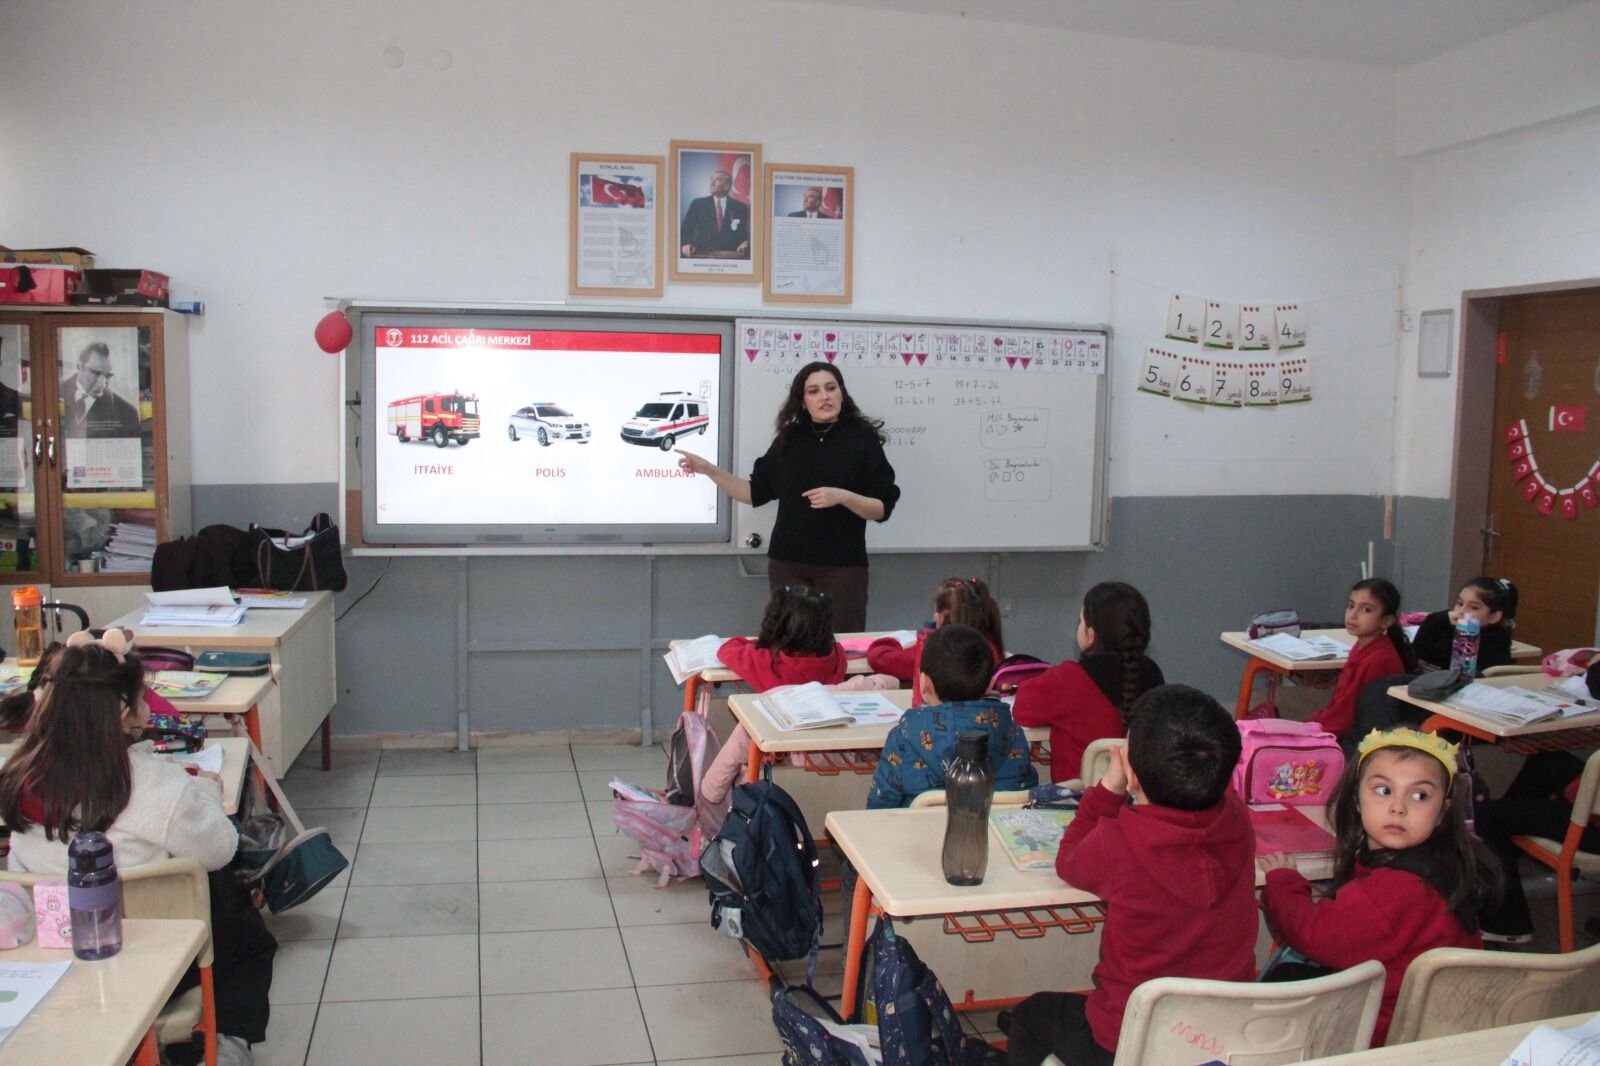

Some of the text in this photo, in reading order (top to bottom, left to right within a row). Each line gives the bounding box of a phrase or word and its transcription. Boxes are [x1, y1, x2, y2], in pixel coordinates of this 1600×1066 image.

[1177, 313, 1183, 330] 1
[1211, 320, 1222, 338] 2
[410, 332, 530, 346] 112 ACİL ÇAĞRI MERKEZİ
[1245, 324, 1255, 341] 3
[1281, 322, 1292, 339] 4
[1146, 365, 1159, 383] 5
[1180, 374, 1191, 392] 6
[1216, 380, 1226, 396] 7
[1250, 380, 1260, 397] 8
[1282, 378, 1292, 395] 9
[414, 464, 454, 476] İTFAİYE
[536, 466, 566, 478] POLİS
[635, 468, 696, 479] AMBULANS
